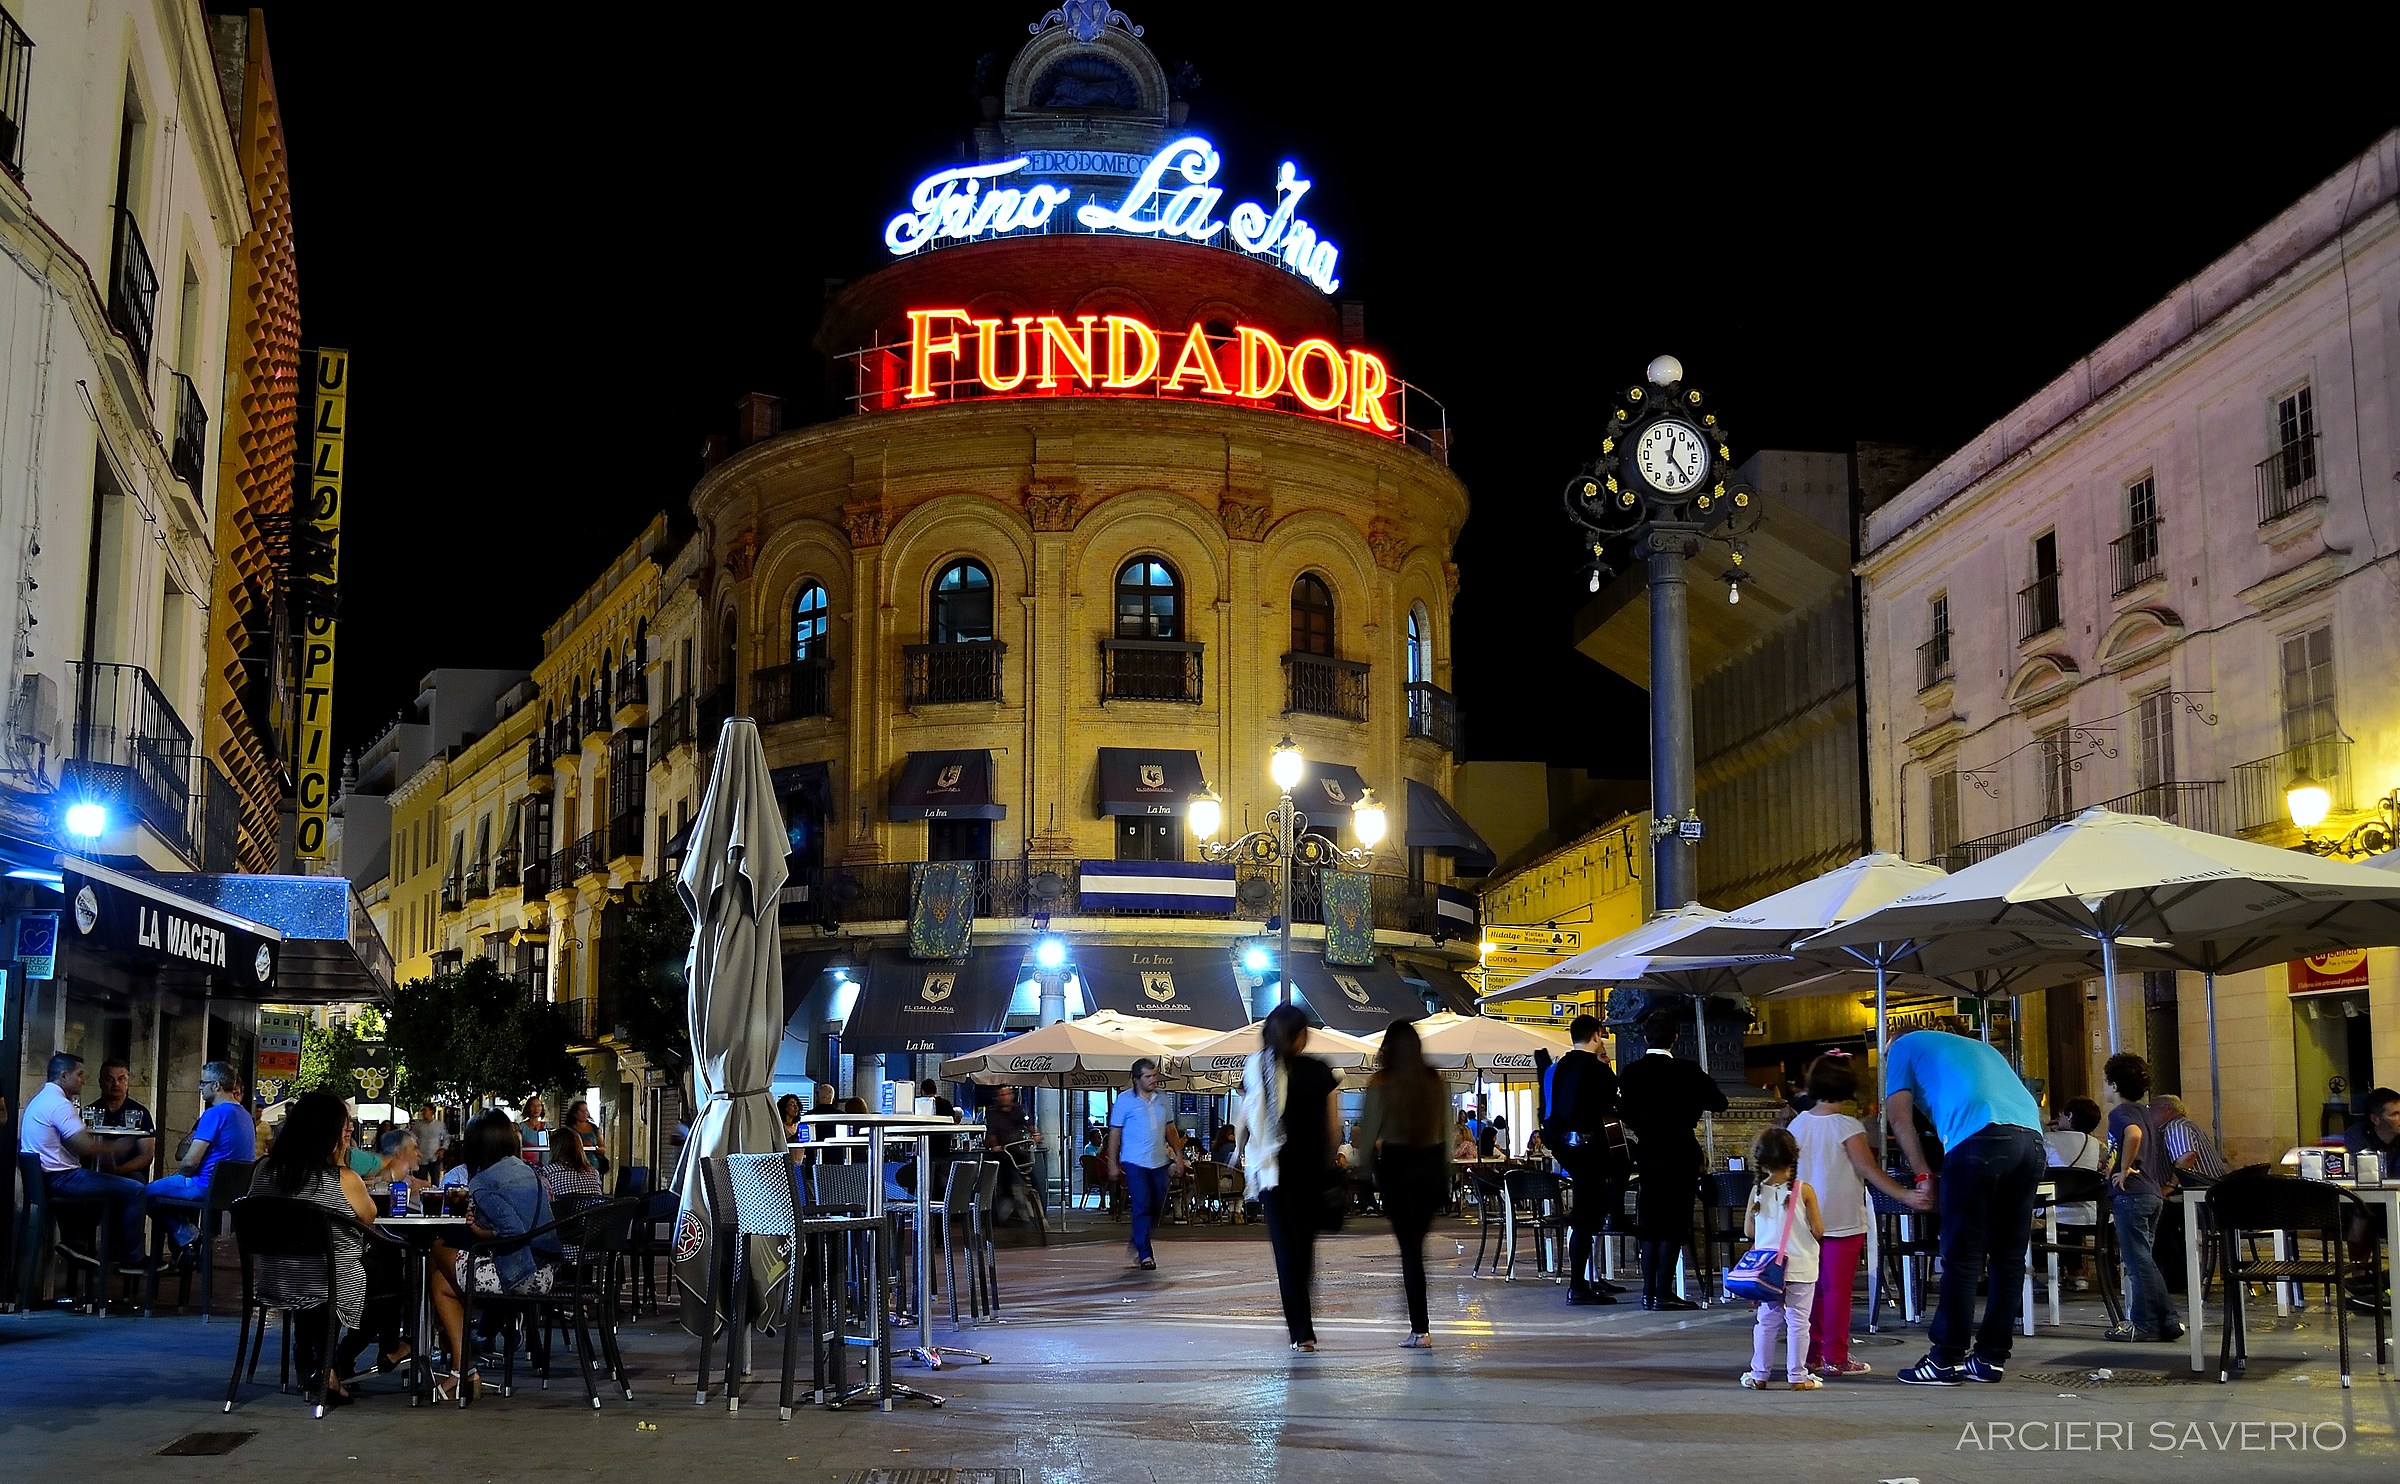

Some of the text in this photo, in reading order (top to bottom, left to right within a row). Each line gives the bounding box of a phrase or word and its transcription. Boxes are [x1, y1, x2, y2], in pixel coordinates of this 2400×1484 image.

[885, 156, 1071, 255] Fino
[1077, 136, 1224, 240] La
[905, 309, 1397, 432] FUNDADOR
[924, 808, 935, 817] La
[1146, 805, 1158, 814] La
[138, 906, 161, 950] LA
[167, 915, 226, 968] MACETA
[1490, 931, 1521, 940] Hidalgo
[1132, 953, 1174, 965] La Ina
[1487, 955, 1518, 963] correos
[906, 1040, 935, 1050] La Ina
[1010, 1055, 1054, 1072] Coca-Cola
[1211, 1054, 1248, 1070] Coca-Col
[1492, 1053, 1532, 1067] Coca-Cola
